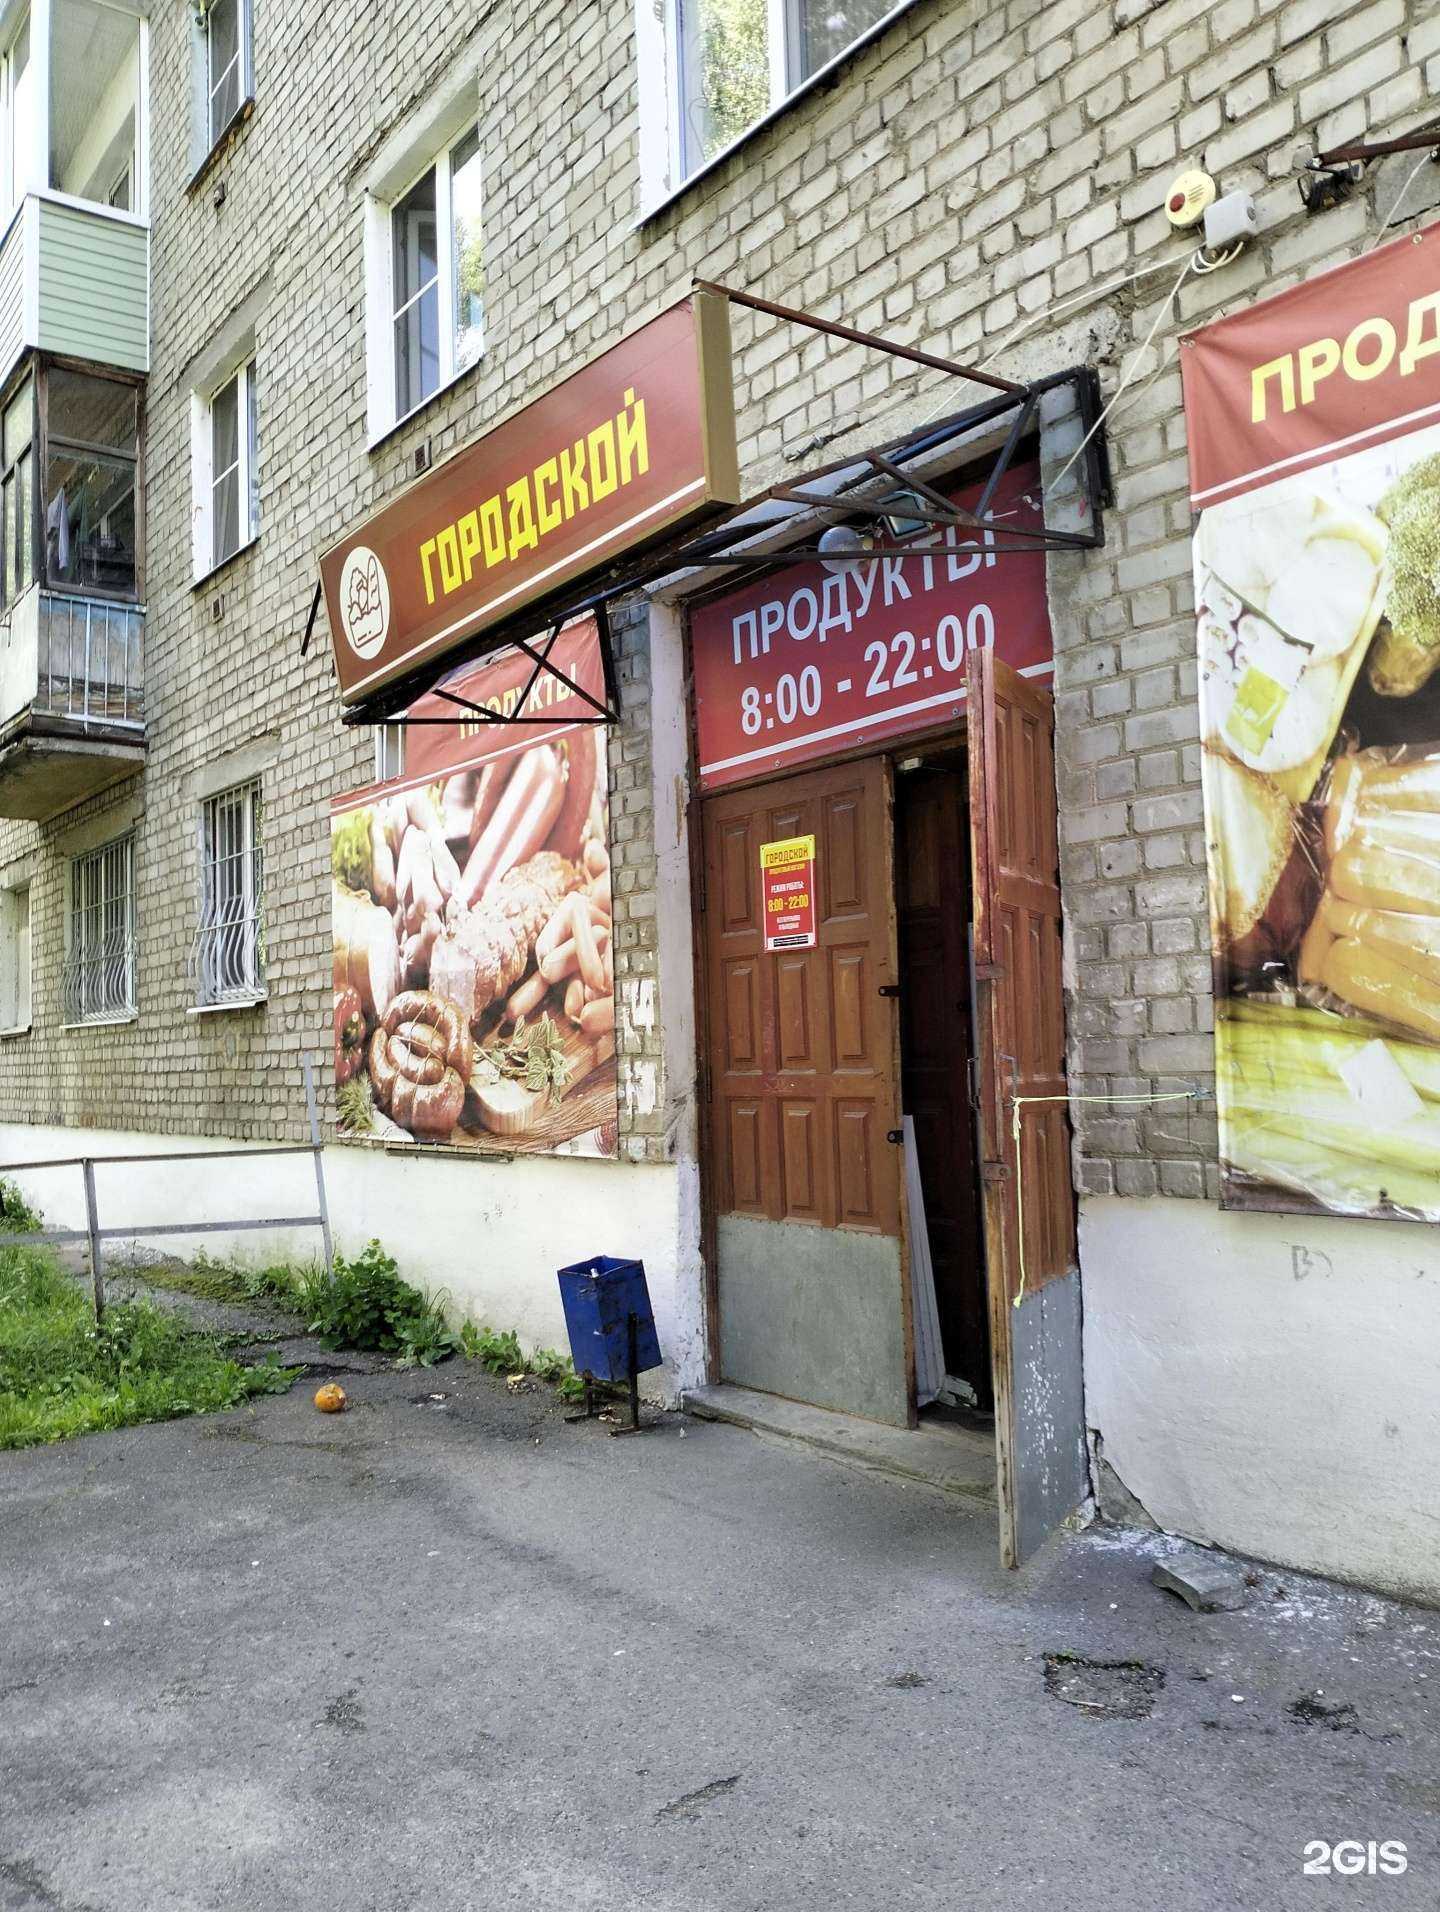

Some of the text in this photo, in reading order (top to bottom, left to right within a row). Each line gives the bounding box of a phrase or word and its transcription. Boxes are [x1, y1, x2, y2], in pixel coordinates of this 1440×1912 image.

[419, 386, 650, 605] ГОРОДСКОЙ
[741, 664, 822, 736] 8:00
[863, 603, 995, 698] 22:00
